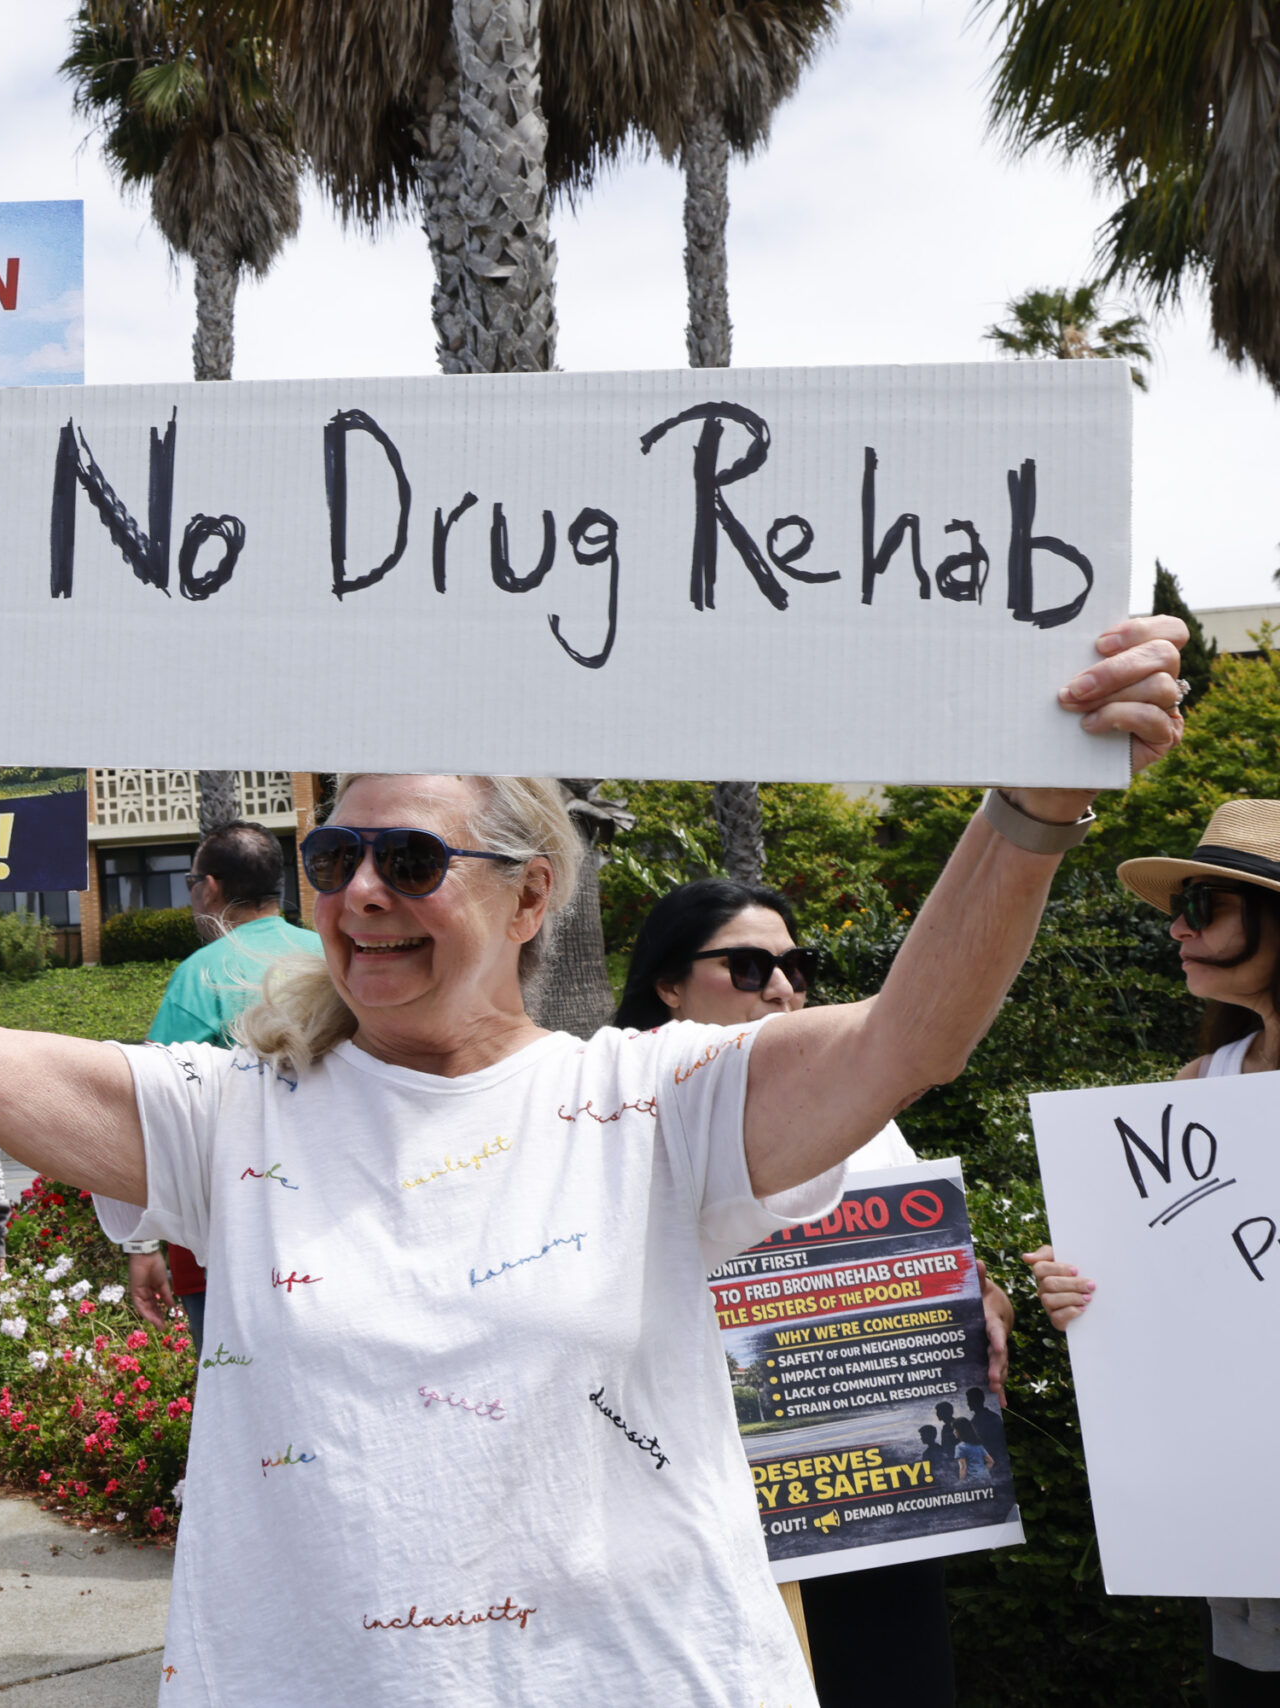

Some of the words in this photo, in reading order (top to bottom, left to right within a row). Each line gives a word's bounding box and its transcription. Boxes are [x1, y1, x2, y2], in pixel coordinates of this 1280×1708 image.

[50, 405, 246, 601] No
[324, 408, 621, 669] Drug
[640, 400, 1094, 630] Rehab
[1114, 1103, 1217, 1198] NO
[708, 1259, 757, 1278] UNITY
[762, 1252, 809, 1271] FIRST!
[1232, 1216, 1280, 1281] P
[719, 1289, 741, 1305] TO
[745, 1281, 781, 1302] FRED
[783, 1273, 834, 1296] BROWN
[836, 1265, 891, 1286] REHAB
[893, 1254, 958, 1278] CENTER
[751, 1297, 818, 1321] SISTERS
[820, 1296, 837, 1310] OF
[839, 1291, 864, 1307] THE
[864, 1280, 922, 1303] POOR!
[775, 1328, 811, 1346] WHY
[814, 1321, 861, 1340] WE'RE
[863, 1309, 954, 1332] CONCERNED:
[777, 1351, 824, 1368] SAFETY
[826, 1349, 839, 1360] OF
[840, 1346, 861, 1358] OUR
[862, 1330, 966, 1354] NEIGHBORHOODS
[781, 1367, 826, 1384] IMPACT
[829, 1366, 844, 1376] ON
[845, 1356, 899, 1375] FAMILIES
[900, 1356, 908, 1366] &
[909, 1347, 965, 1365] SCHOOLS
[784, 1386, 816, 1401] LACK
[818, 1385, 831, 1396] OF
[832, 1373, 905, 1394] COMMUNITY
[907, 1367, 943, 1382] INPUT
[787, 1400, 831, 1417] STRAIN
[833, 1399, 849, 1409] ON
[850, 1391, 888, 1407] LOCAL
[889, 1382, 958, 1401] RESOURCES
[751, 1448, 883, 1485] DESERVES
[788, 1481, 810, 1504] &
[815, 1461, 934, 1499] SAFETY!
[771, 1516, 807, 1535] OUT!
[844, 1503, 894, 1522] DEMAND
[897, 1488, 994, 1513] ACCOUNTABILITY!
